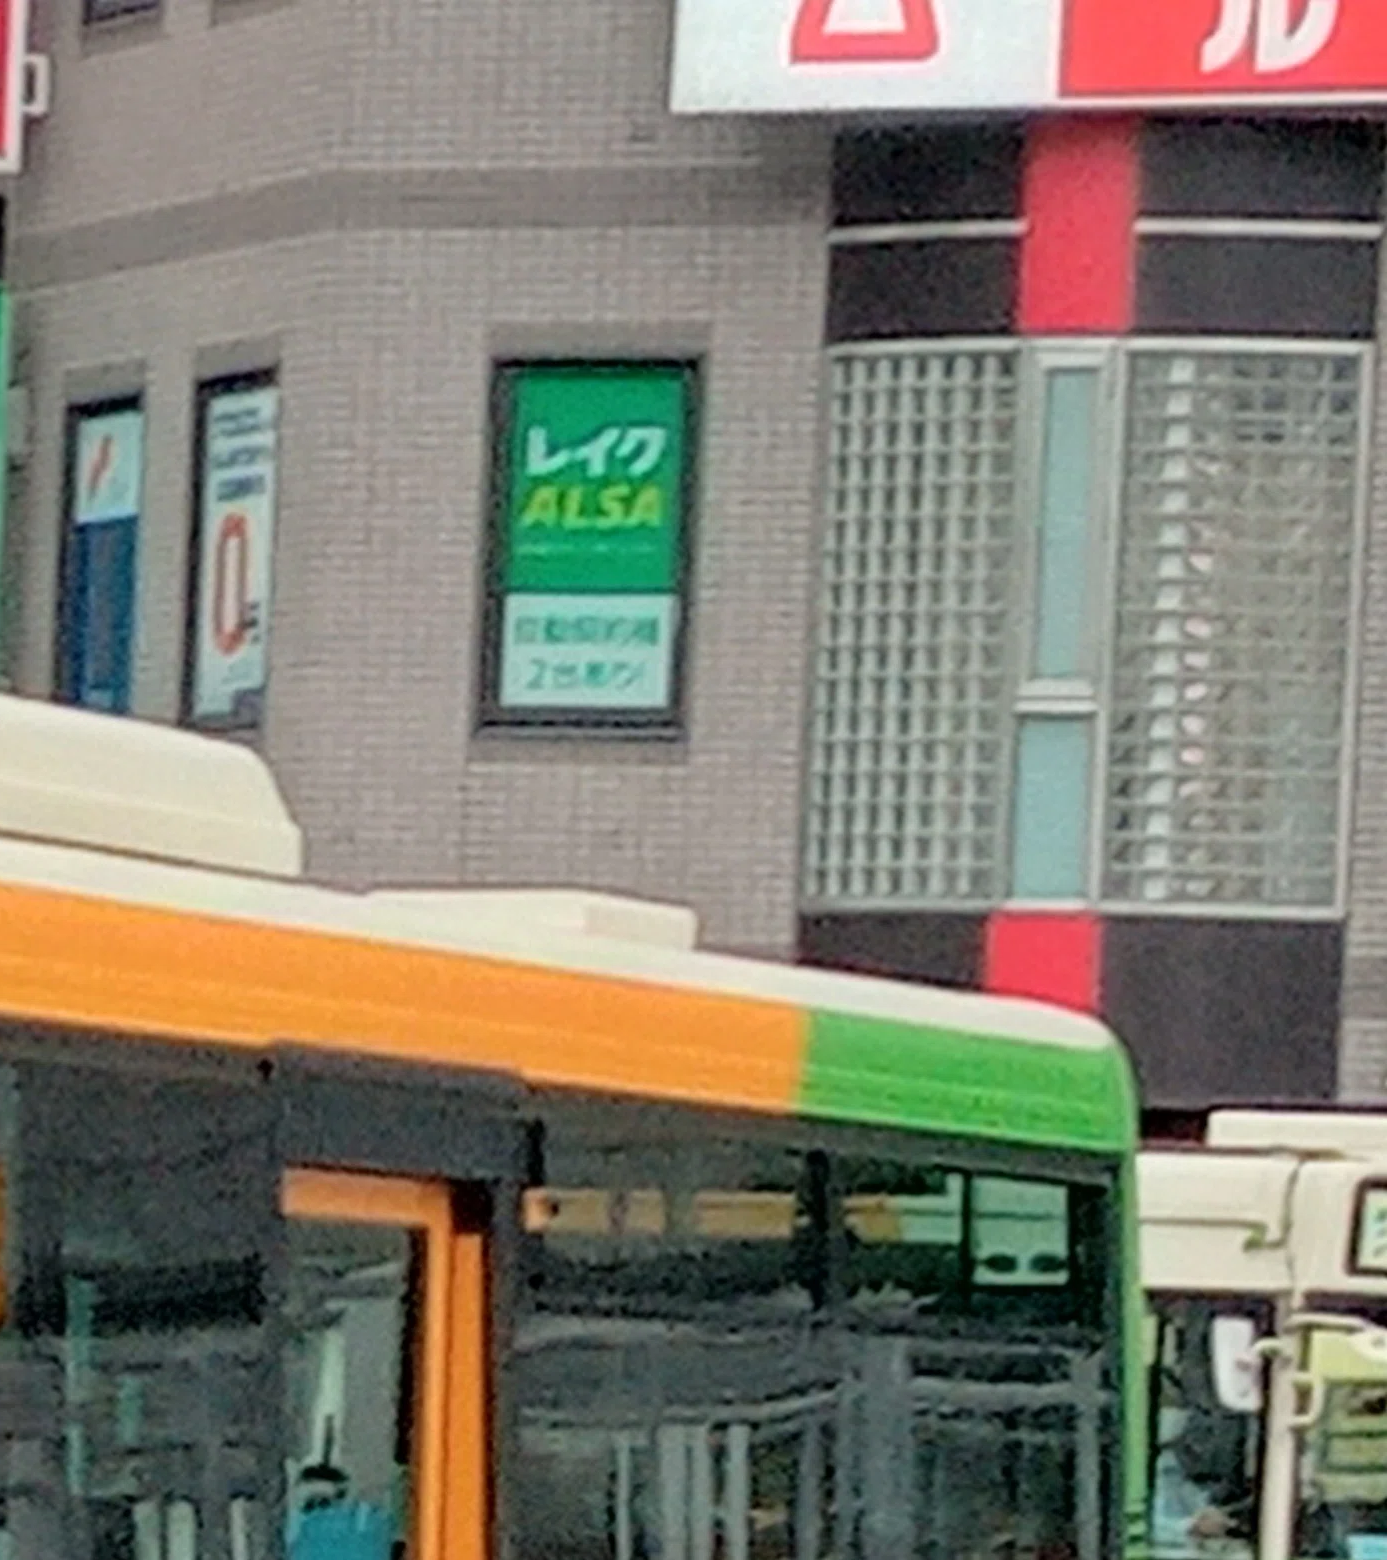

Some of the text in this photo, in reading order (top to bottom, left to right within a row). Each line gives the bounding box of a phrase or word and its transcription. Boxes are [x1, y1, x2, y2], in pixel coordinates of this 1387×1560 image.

[526, 426, 667, 478] レイク
[519, 484, 662, 530] ALSA
